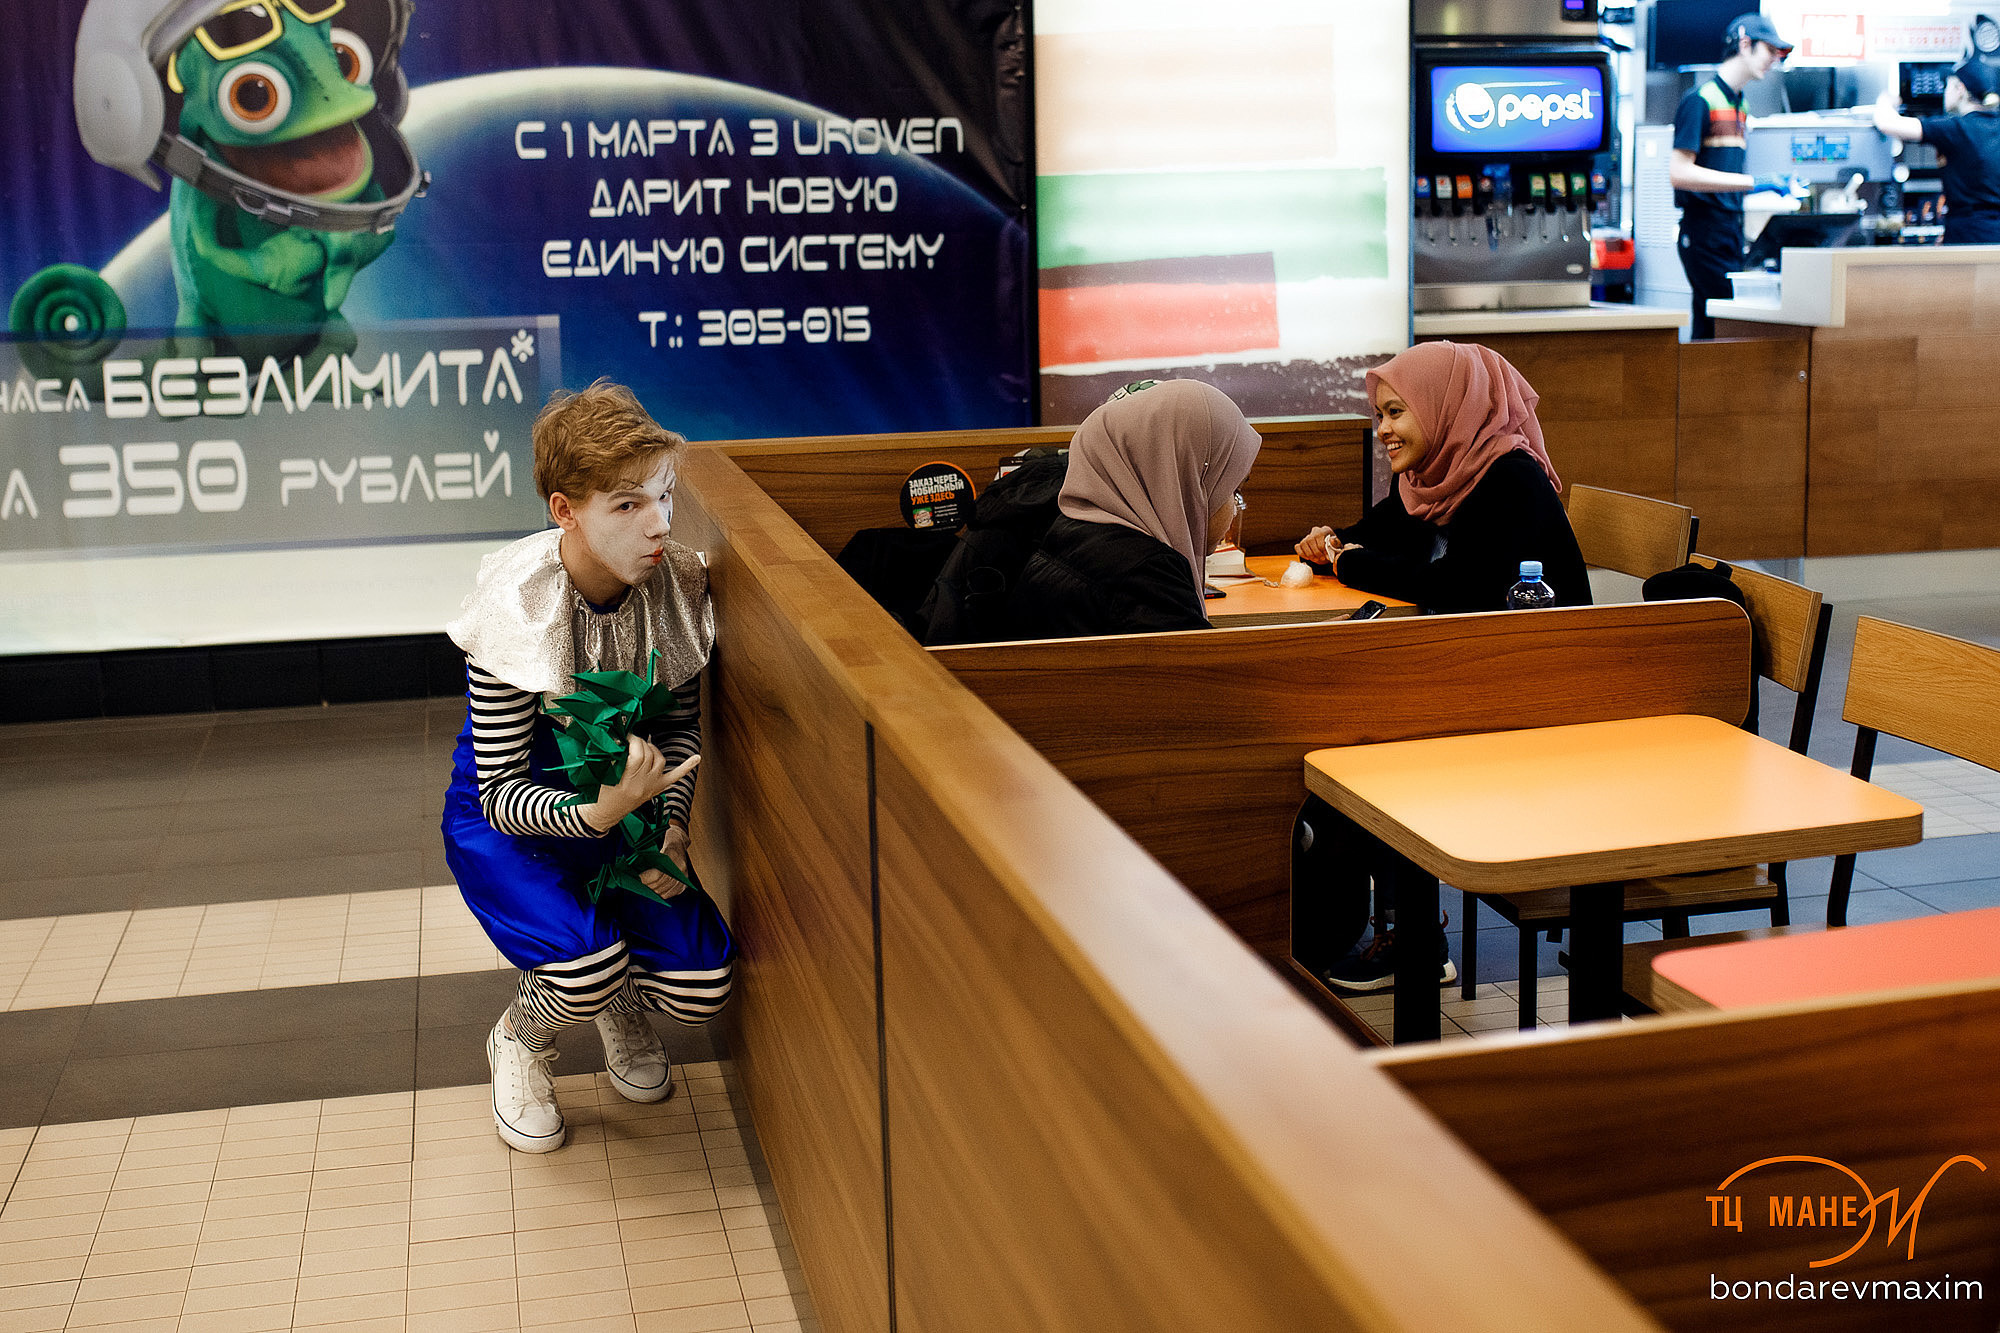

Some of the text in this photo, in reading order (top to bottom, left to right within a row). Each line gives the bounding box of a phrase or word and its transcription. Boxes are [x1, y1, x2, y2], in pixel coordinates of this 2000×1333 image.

[1498, 88, 1594, 128] pepsi
[514, 121, 547, 160] С
[561, 120, 575, 159] 1
[587, 118, 736, 160] МАРТА
[589, 176, 898, 218] ДАРИТ НОВУЮ
[542, 233, 944, 278] ЕДИНУЮ СИСТЕМУ
[698, 306, 871, 347] 305-015
[58, 439, 248, 519] 350
[280, 430, 513, 507] РУБЛЕЙ
[908, 473, 958, 489] ЗАКАЗ ЧЕРЕЗ
[910, 478, 964, 497] МОБИЛЬНЫЙ
[911, 491, 955, 505] УЖЕ ЗДЕСЬ
